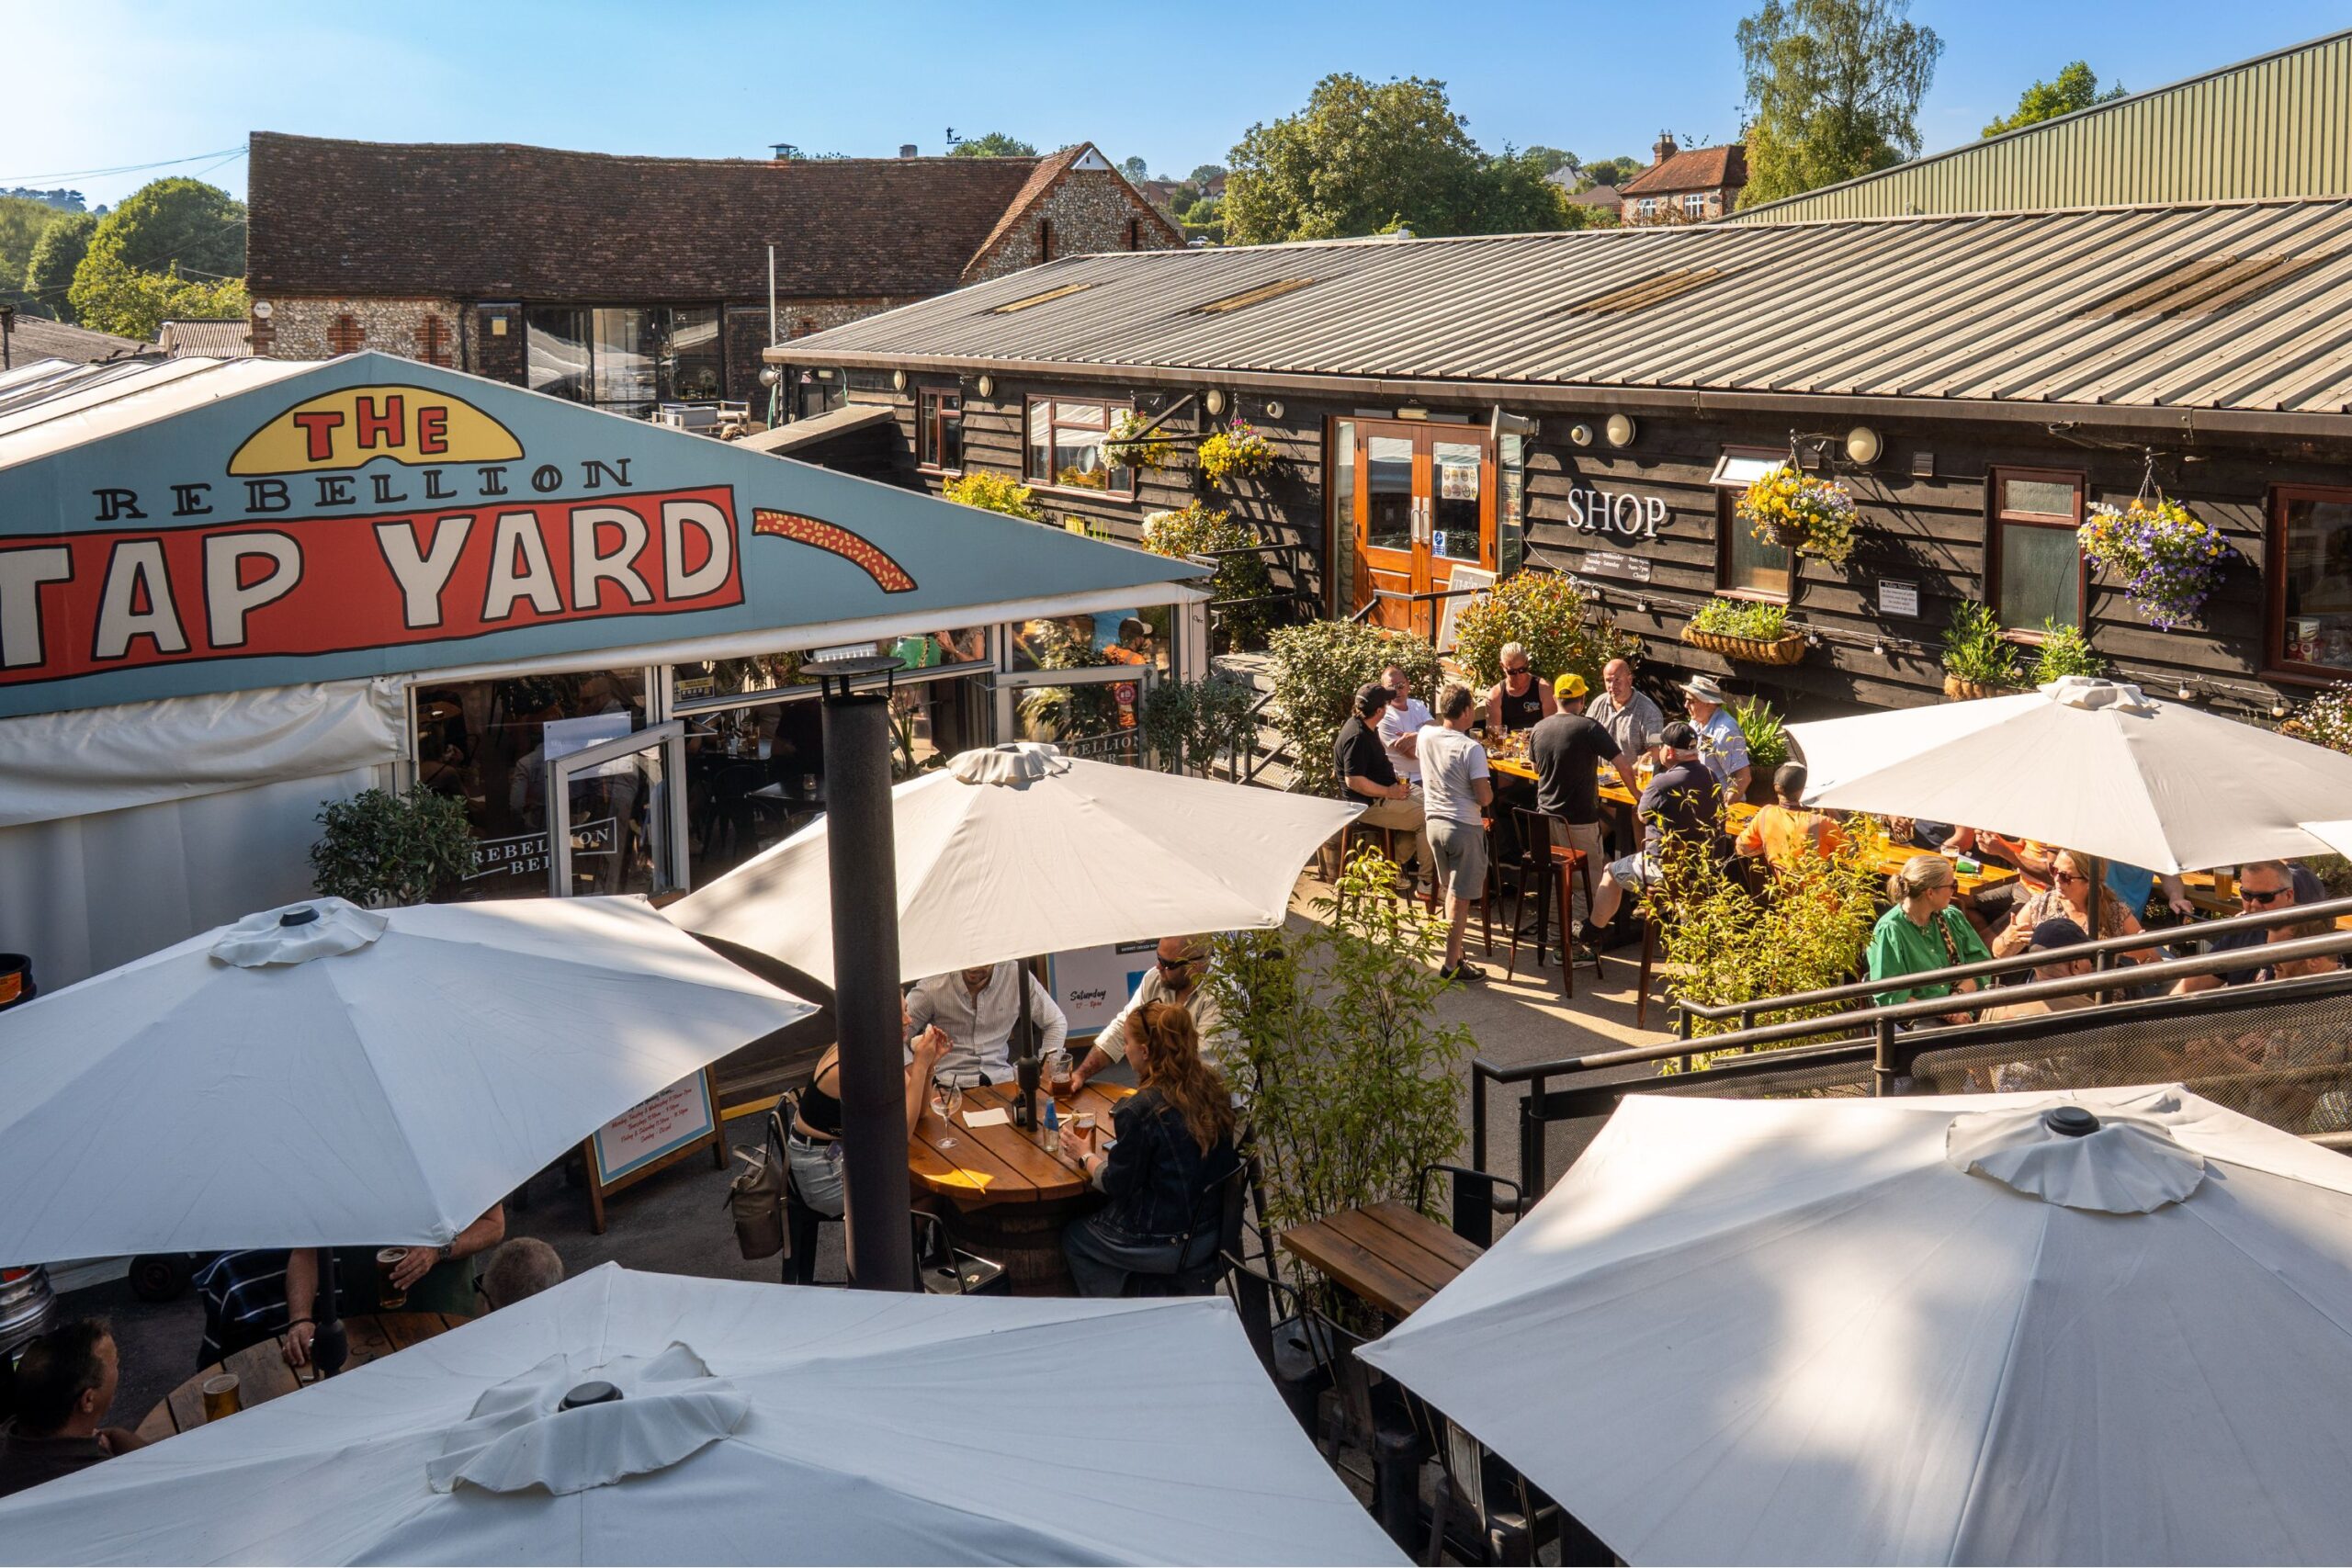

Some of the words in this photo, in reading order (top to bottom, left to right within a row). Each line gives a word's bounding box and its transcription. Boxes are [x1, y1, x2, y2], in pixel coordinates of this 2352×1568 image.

[294, 395, 448, 461] THE
[92, 458, 632, 522] REBELLION
[1567, 489, 1666, 537] SHOP
[0, 529, 305, 671] TAP
[372, 499, 734, 630] YARD
[471, 828, 610, 864] REBELON
[1069, 987, 1107, 1002] Saturday
